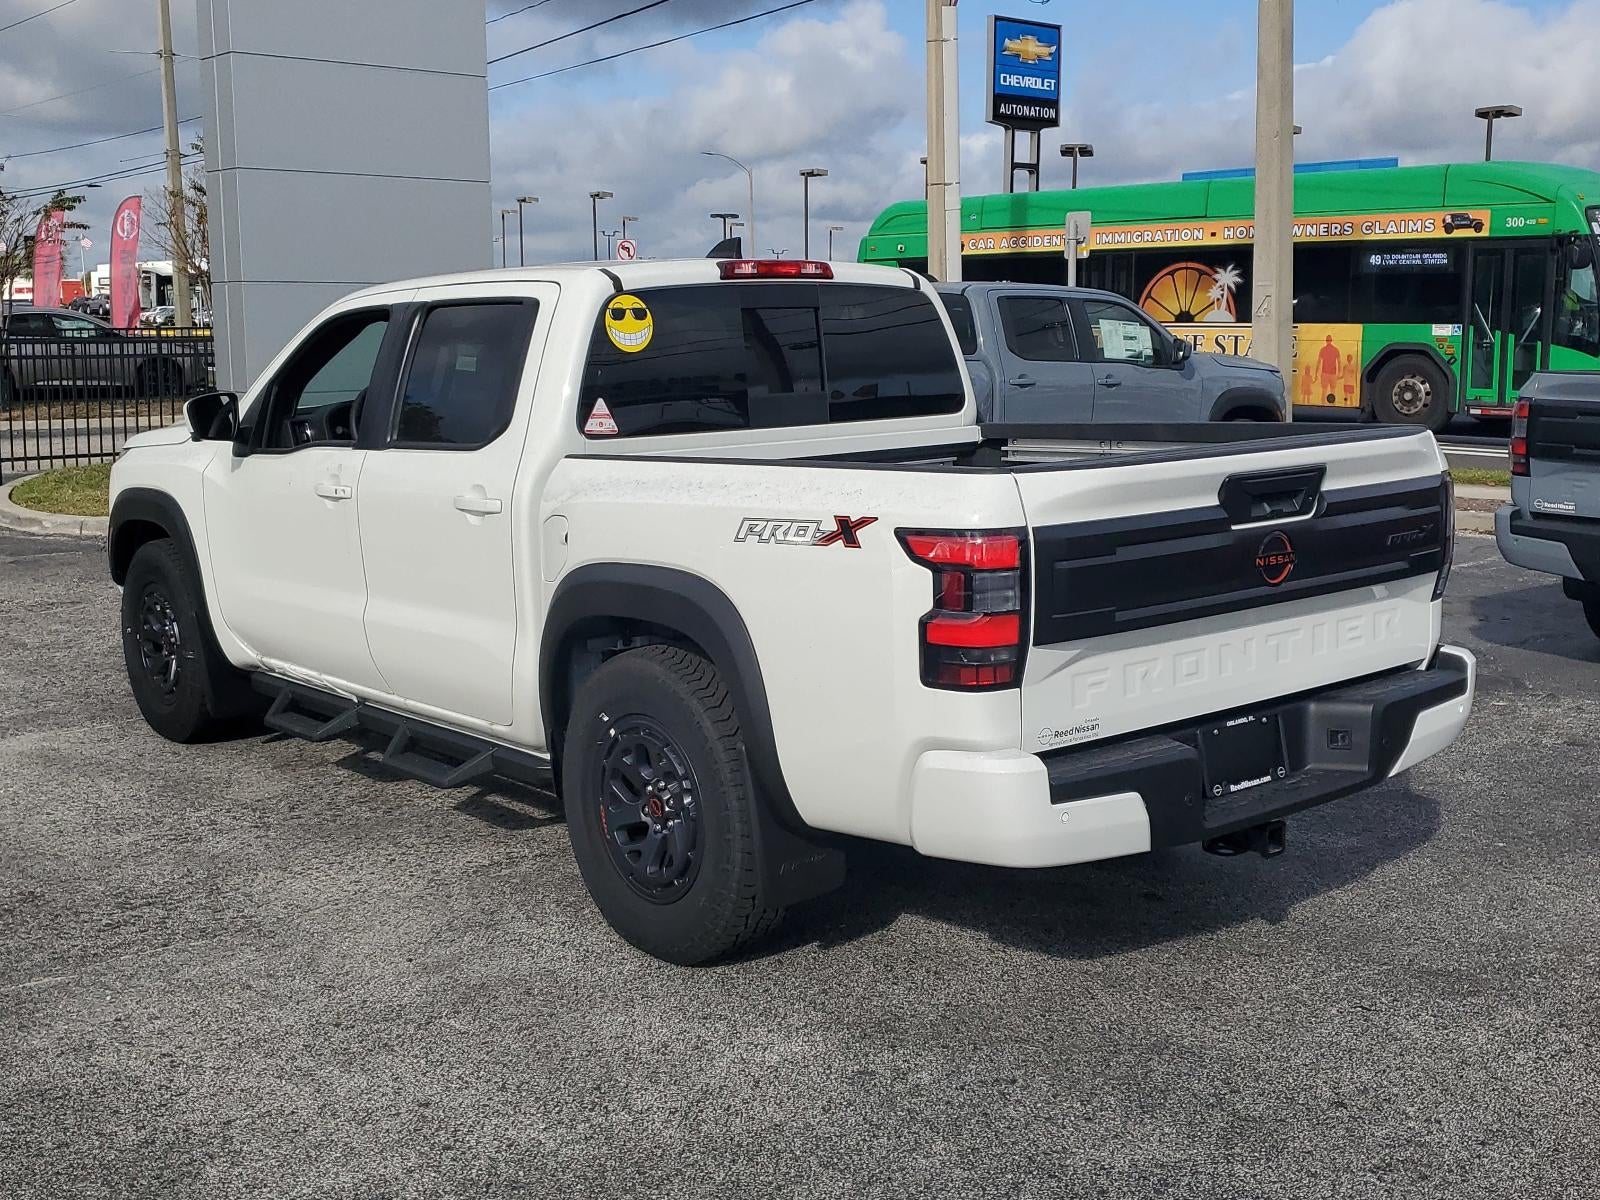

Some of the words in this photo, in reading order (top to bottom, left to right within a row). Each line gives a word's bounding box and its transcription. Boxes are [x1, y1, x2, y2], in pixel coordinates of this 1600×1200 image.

[1000, 73, 1056, 91] CHEVROLET
[1000, 103, 1056, 119] AUTONATION
[968, 238, 995, 250] CAR
[1096, 227, 1204, 245] IMMIGRATION
[1360, 218, 1436, 235] CLAIMS
[1370, 254, 1381, 265] 49
[1255, 553, 1296, 568] NISSAN
[1072, 606, 1401, 710] FRONTIER
[1054, 726, 1074, 739] Reed
[1075, 723, 1100, 735] Nissan
[1230, 775, 1272, 792] ReedNissan.com
